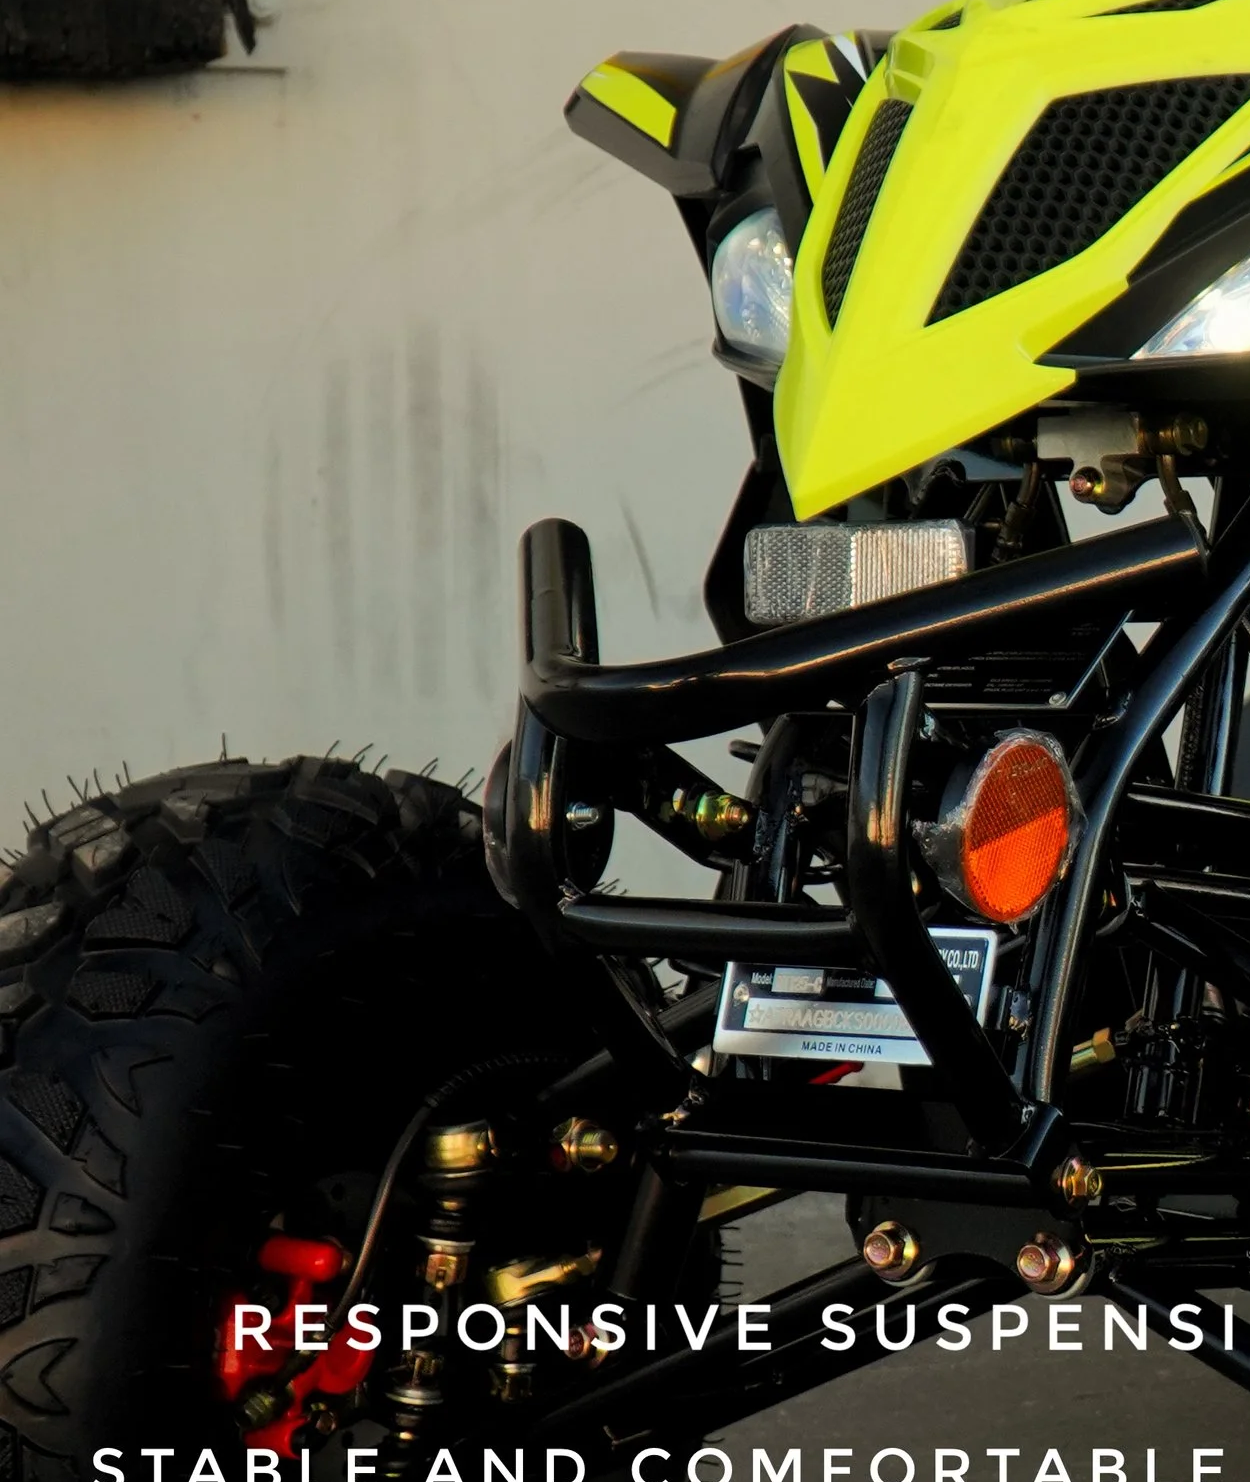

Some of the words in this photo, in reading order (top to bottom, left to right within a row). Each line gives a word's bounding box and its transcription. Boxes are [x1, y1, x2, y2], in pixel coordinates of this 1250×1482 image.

[801, 1040, 832, 1053] MADE
[835, 1042, 846, 1054] IN
[848, 1042, 882, 1056] CHINA
